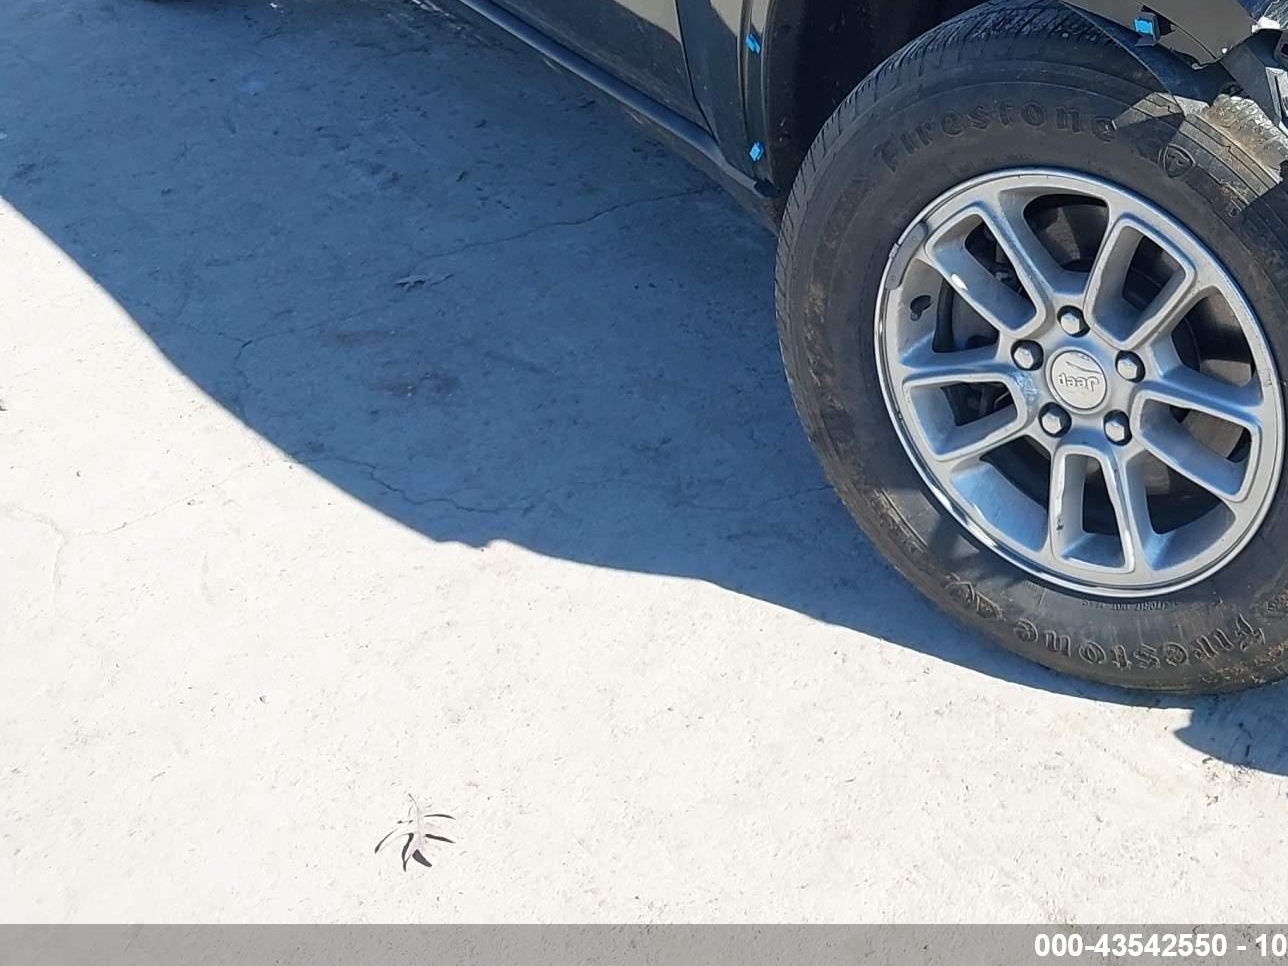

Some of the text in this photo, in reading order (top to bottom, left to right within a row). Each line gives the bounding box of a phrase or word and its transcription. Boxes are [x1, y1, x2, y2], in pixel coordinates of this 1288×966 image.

[873, 98, 1117, 174] Firestone
[1057, 372, 1100, 393] Jeep
[1012, 612, 1266, 670] Firestone
